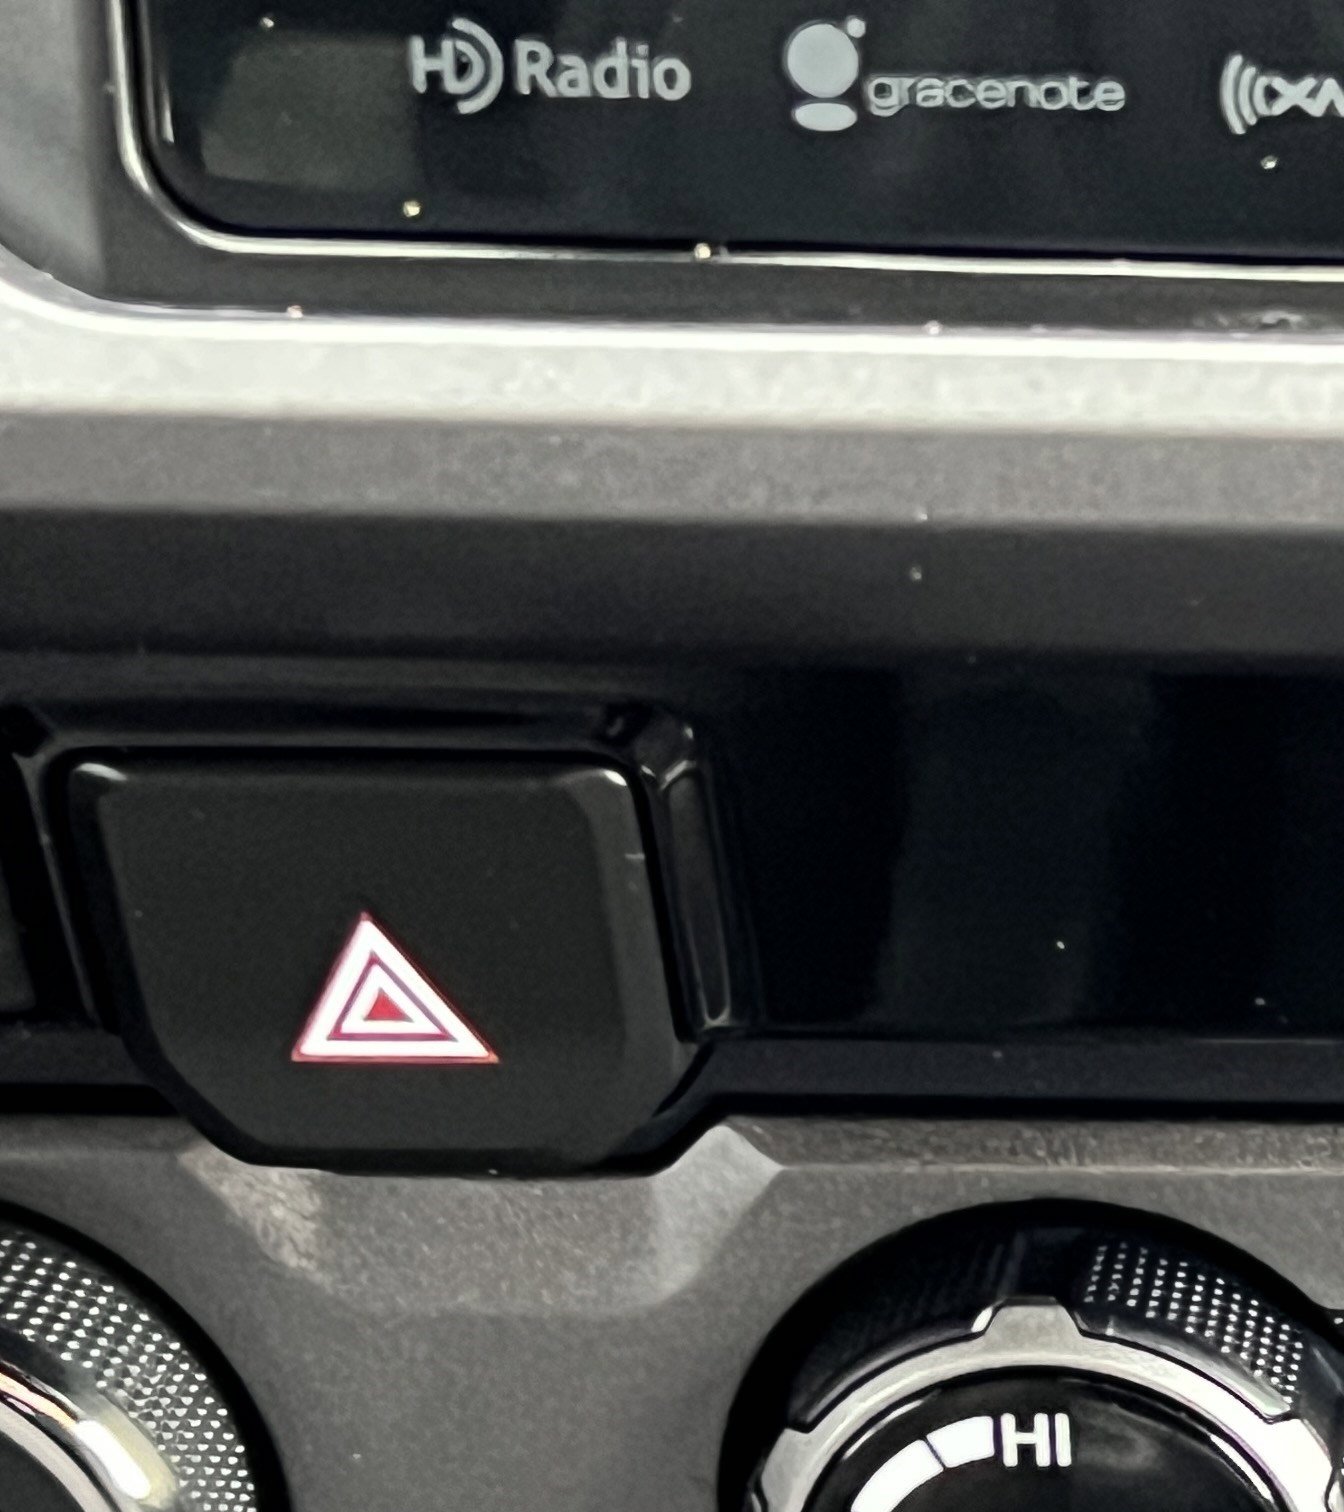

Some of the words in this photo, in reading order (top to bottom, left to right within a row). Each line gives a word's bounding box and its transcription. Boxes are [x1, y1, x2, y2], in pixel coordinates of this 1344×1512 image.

[514, 37, 692, 101] Radio
[865, 76, 1126, 117] gracenote
[1001, 1412, 1073, 1468] HI
